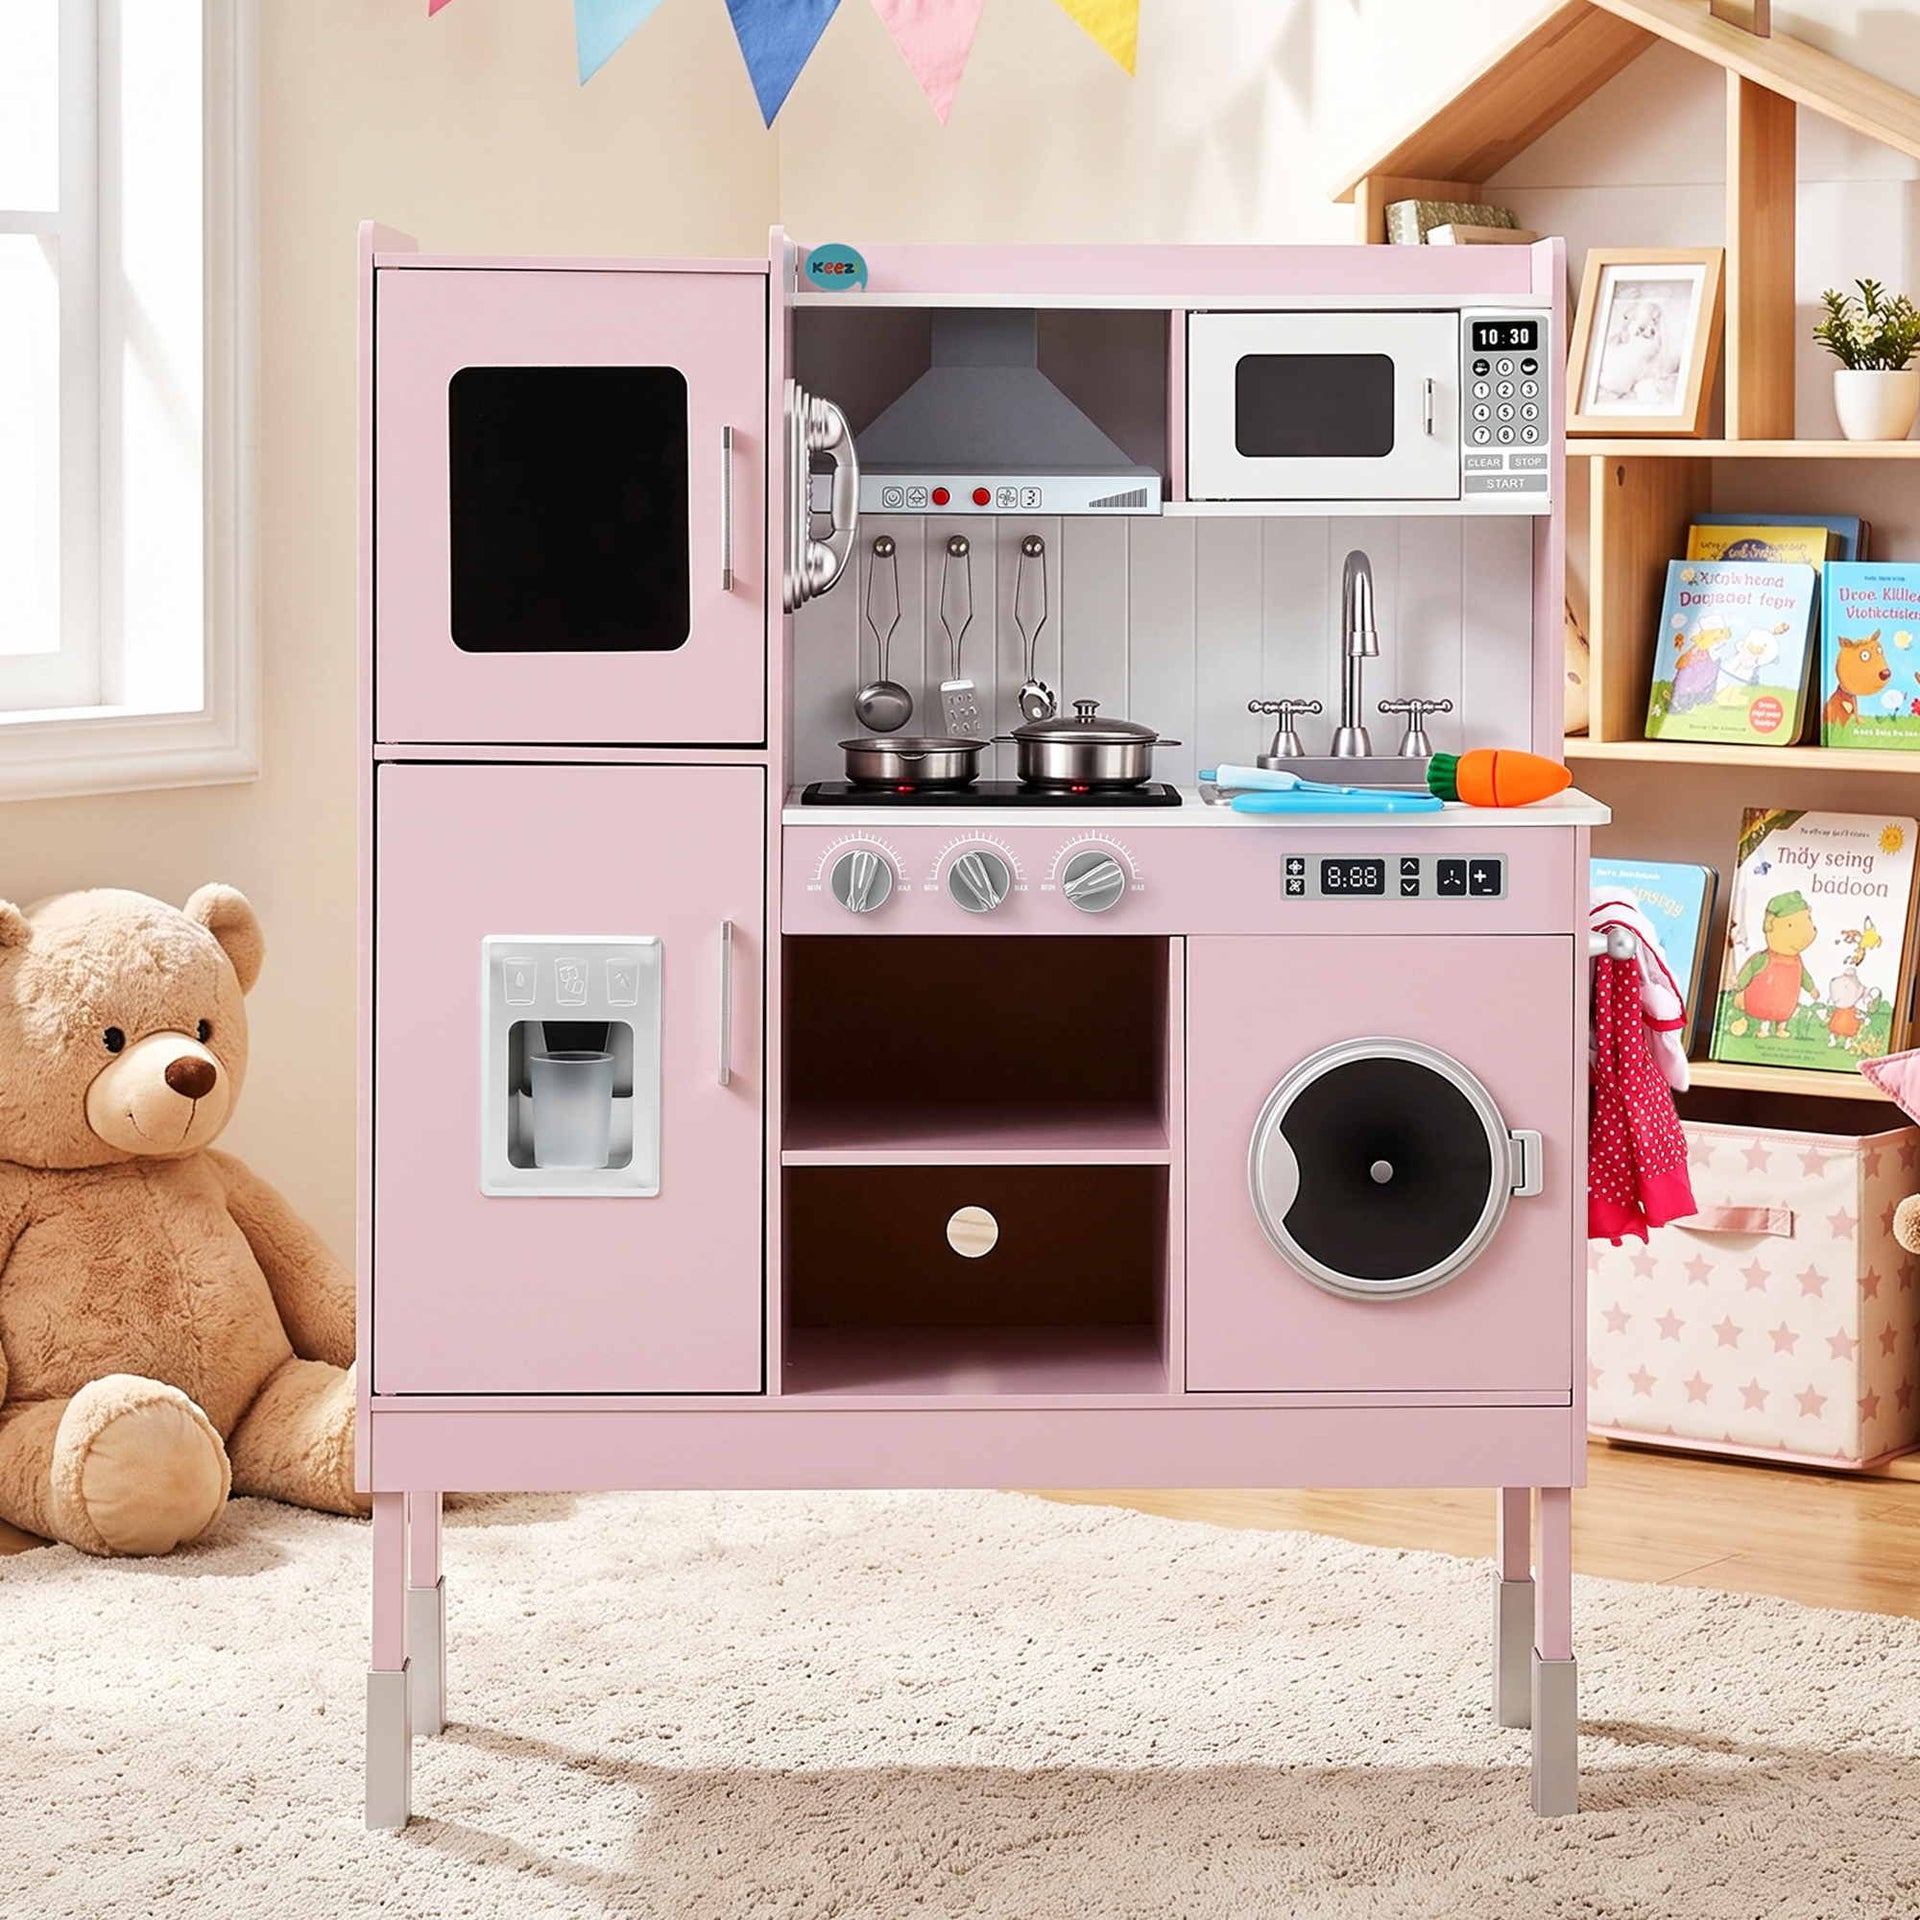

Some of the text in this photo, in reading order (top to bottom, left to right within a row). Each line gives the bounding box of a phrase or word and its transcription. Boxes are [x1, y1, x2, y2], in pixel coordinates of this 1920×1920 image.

[1502, 362, 1509, 372] 0
[1502, 385, 1509, 395] 2
[1526, 384, 1533, 394] 3
[1478, 407, 1533, 417] 4 5 6
[1479, 429, 1533, 440] 7 8 9
[1467, 458, 1501, 468] CLEAR
[1513, 457, 1542, 467] STOP
[1486, 478, 1525, 490] START
[1026, 490, 1036, 506] 3
[1825, 850, 1875, 874] seing
